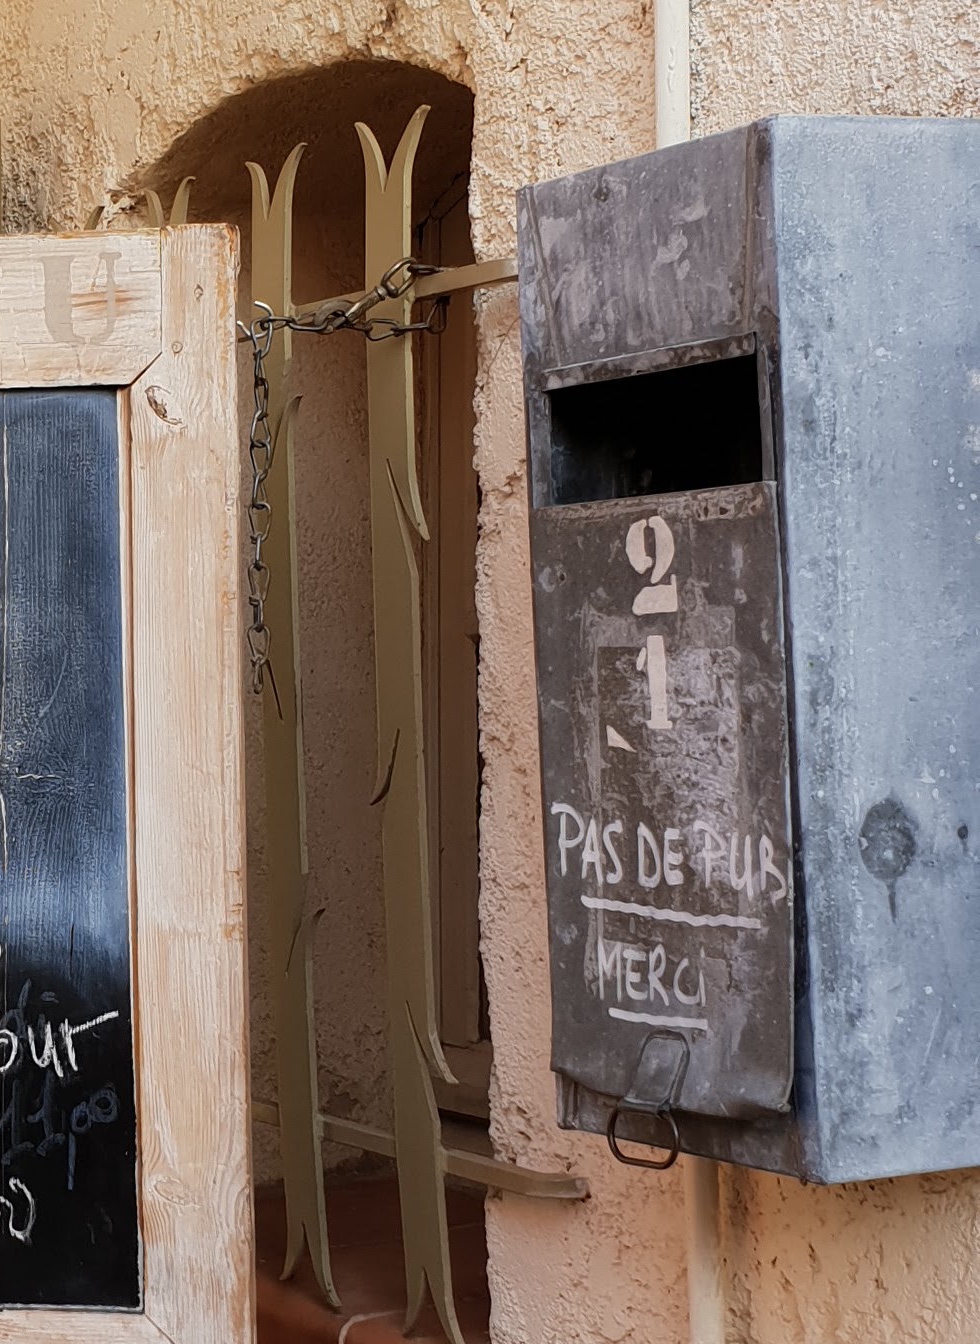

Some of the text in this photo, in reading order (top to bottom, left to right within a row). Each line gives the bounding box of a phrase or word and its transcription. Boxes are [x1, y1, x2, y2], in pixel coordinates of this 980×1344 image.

[551, 802, 788, 904] PAS DE PUB
